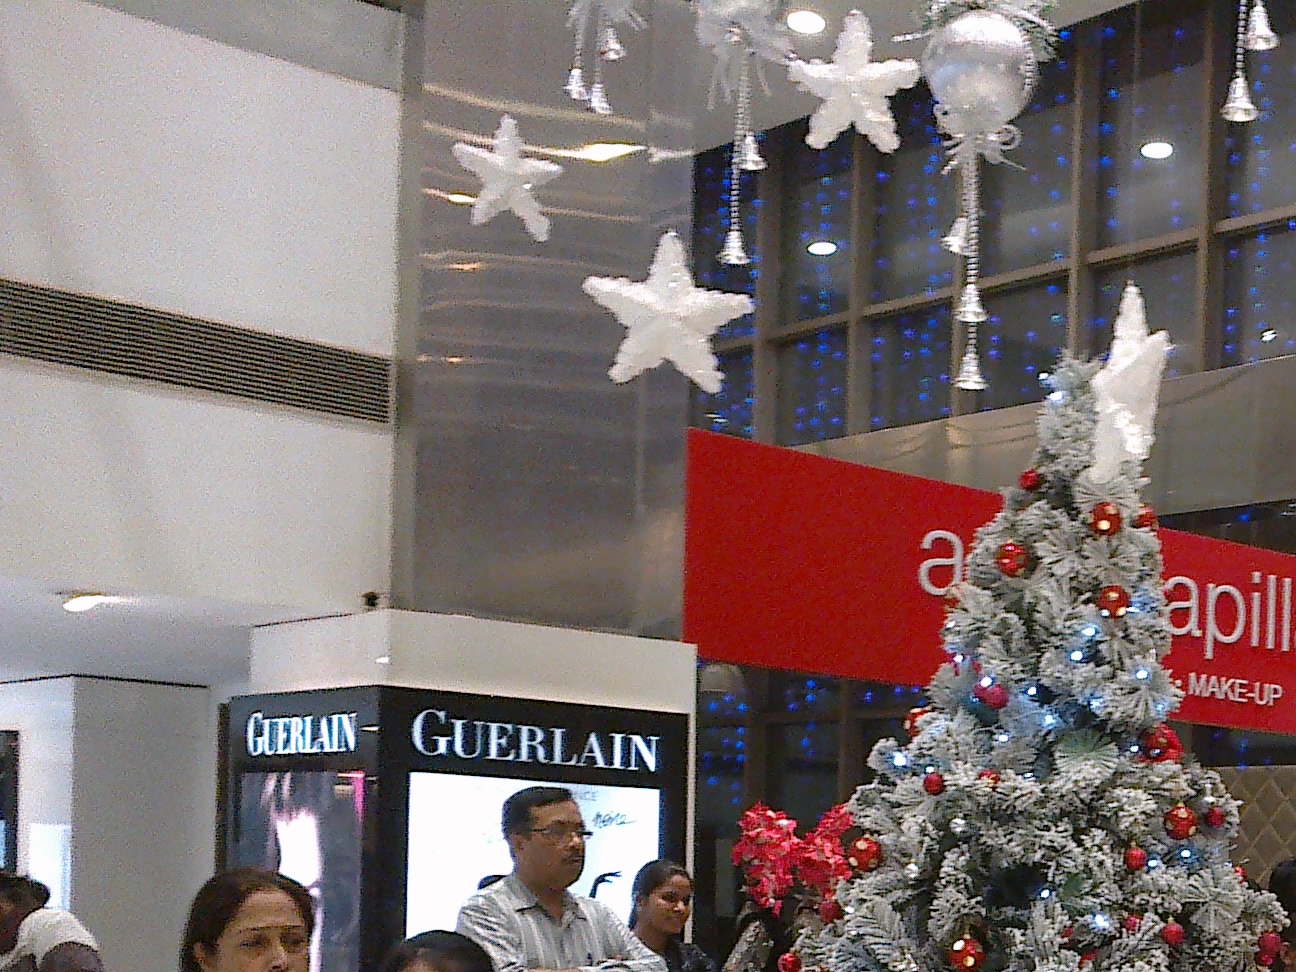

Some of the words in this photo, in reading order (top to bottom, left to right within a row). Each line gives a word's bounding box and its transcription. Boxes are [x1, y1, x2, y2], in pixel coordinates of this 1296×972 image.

[1187, 671, 1284, 707] MAKE-UP
[246, 711, 358, 757] GUERLAIN
[410, 708, 661, 773] GUERLAIN
